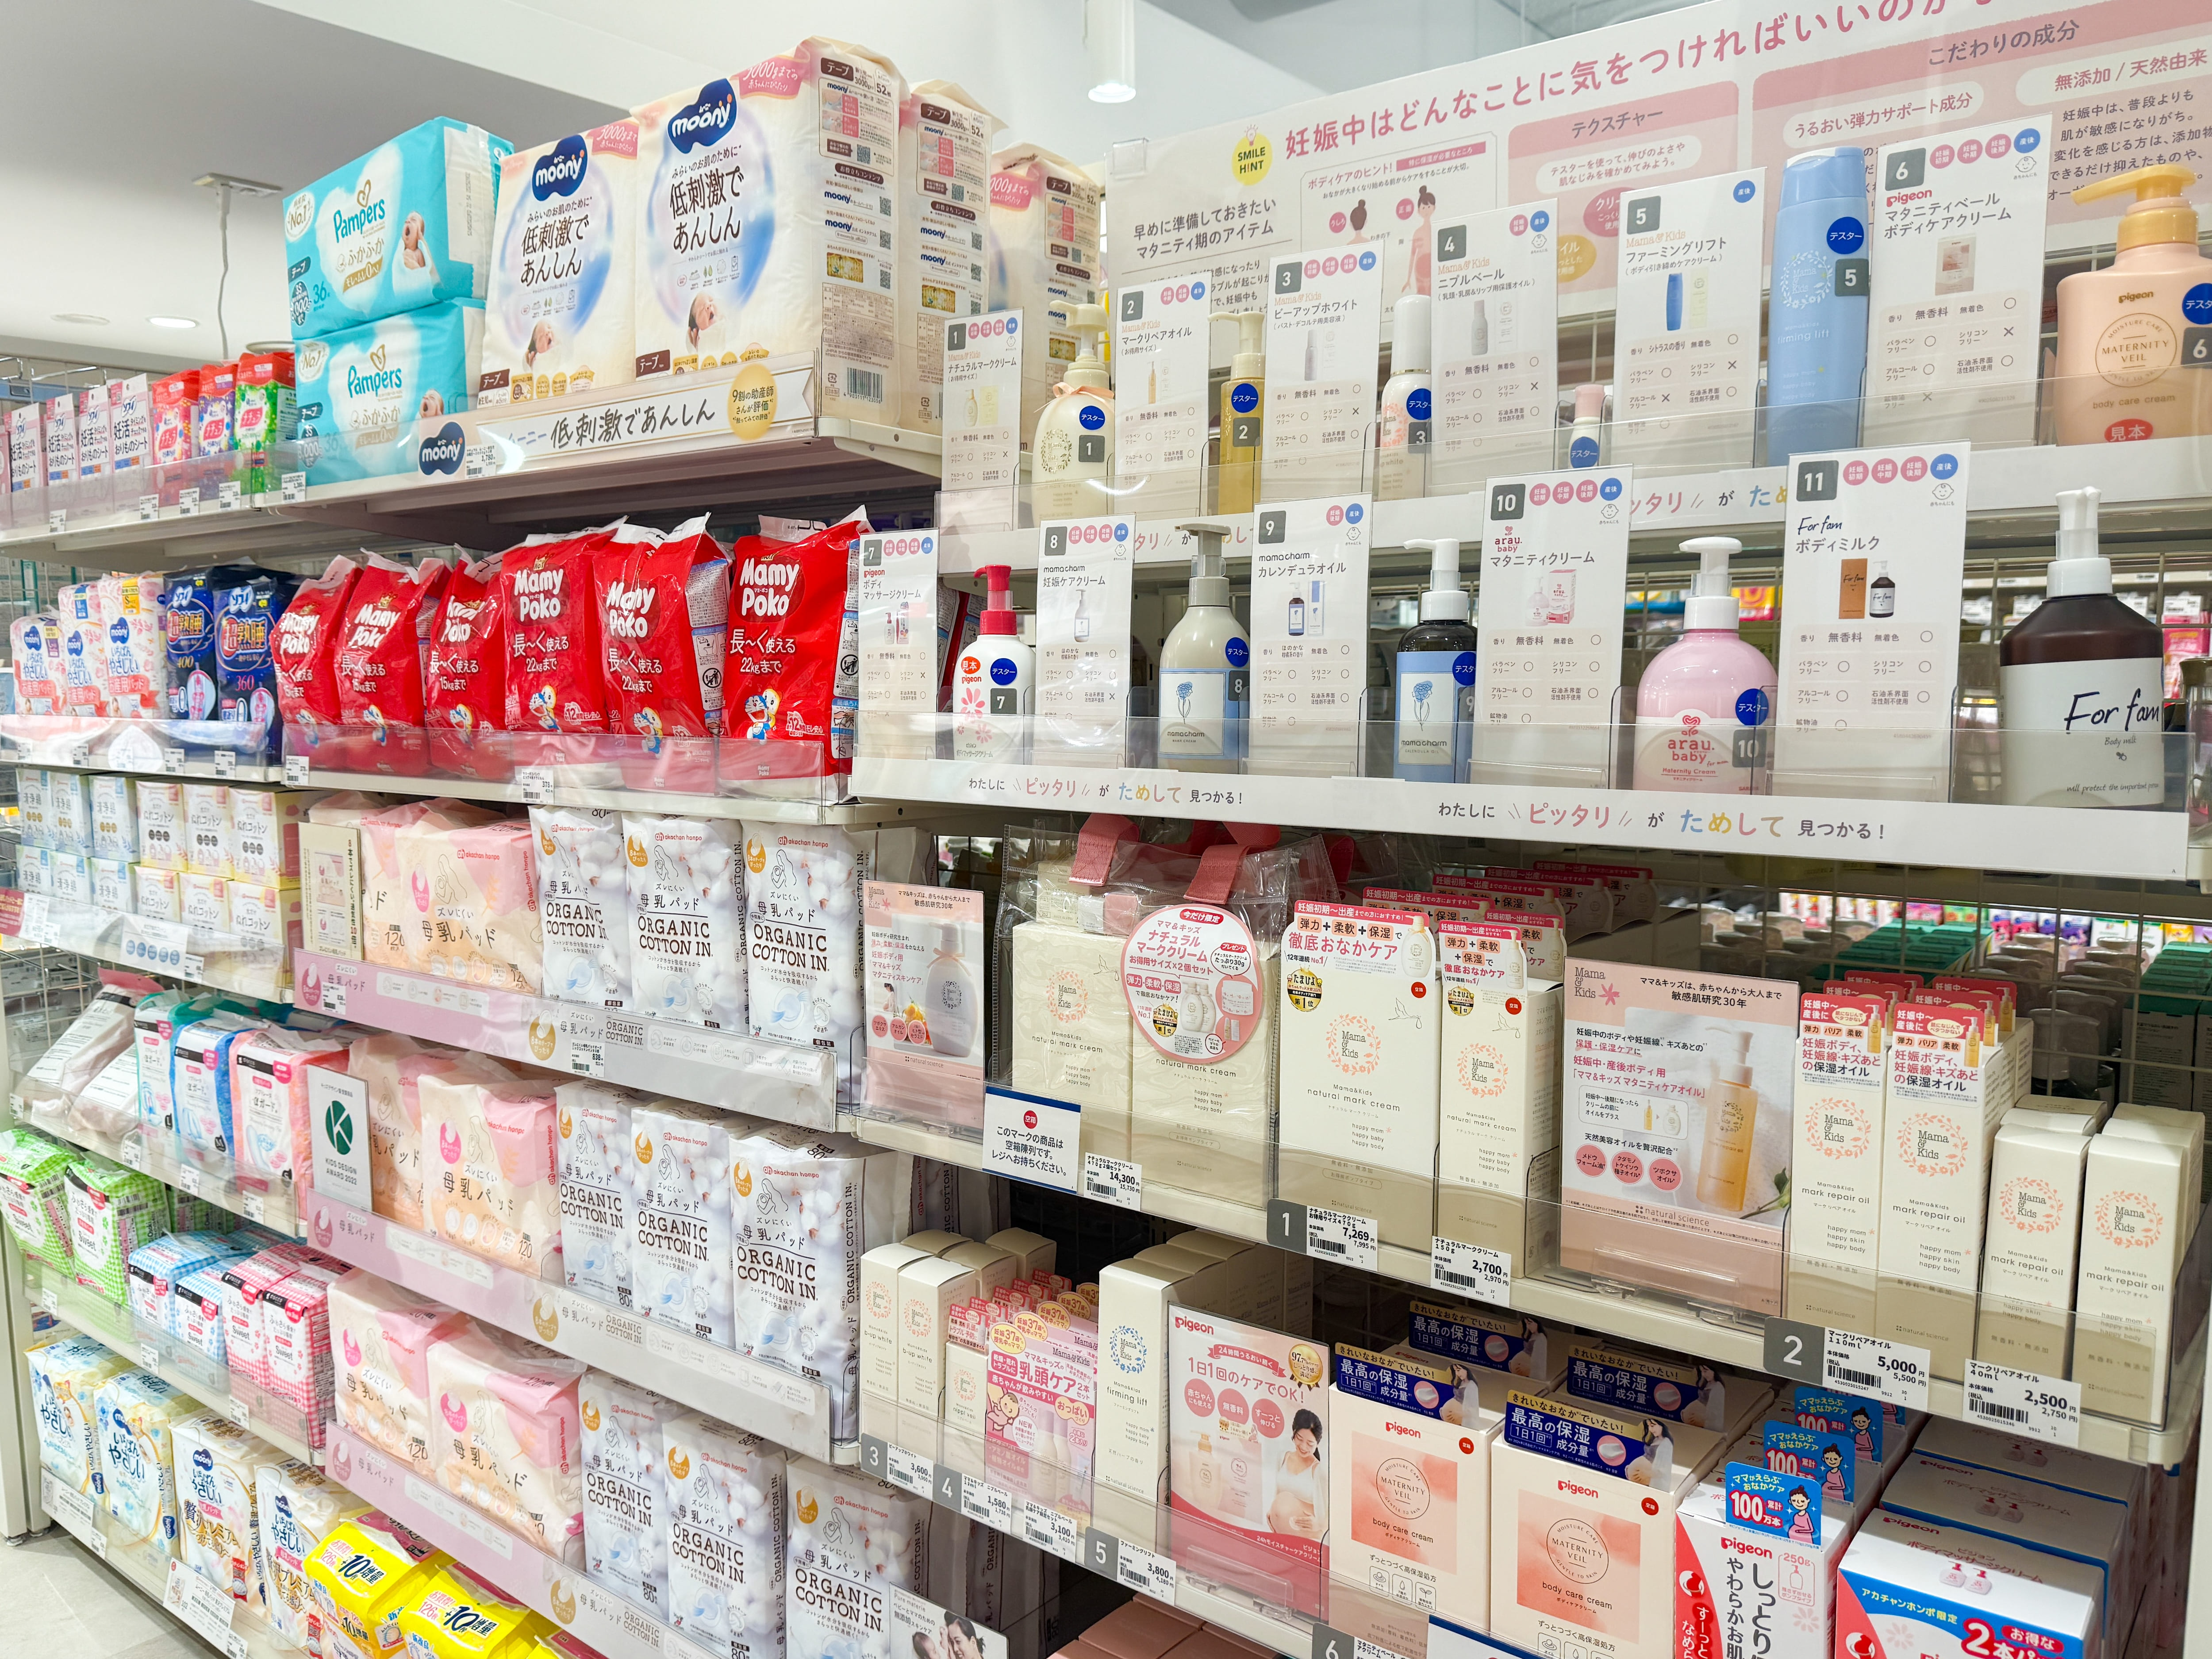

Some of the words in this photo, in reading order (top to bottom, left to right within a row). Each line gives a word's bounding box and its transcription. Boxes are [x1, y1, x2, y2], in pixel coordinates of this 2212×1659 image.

[1929, 20, 2079, 66] こだわりの成分
[1285, 0, 1991, 160] 妊娠中はどんなことに気をつければいいの
[2054, 67, 2110, 92] 無添加
[2130, 49, 2207, 78] 天然由来
[1795, 92, 1973, 138] うるおい弾力サポート成分
[2063, 89, 2193, 122] 妊娠中は、普段よりも
[1572, 111, 1663, 138] テクスチャー
[2061, 111, 2193, 142] 肌が敏感になりがち。
[1238, 147, 1266, 161] SMILE
[1551, 143, 1685, 175] テスターを使って、伸びのよさや
[1559, 159, 1675, 187] 肌なじみを確かめてみよう。
[1895, 161, 1909, 180] 6
[669, 166, 744, 220] 低刺激で
[1887, 188, 1932, 207] pigeon
[1886, 193, 2000, 221] マタニティベール
[334, 199, 385, 243] Pampers
[1134, 198, 1276, 241] 早めに準備しておきたい
[1885, 208, 2012, 240] ボディケアクリーム
[521, 214, 589, 257] 低刺激で
[1137, 219, 1273, 259] マタニティ期のアイテム
[1626, 236, 1727, 263] ファーミングリフト
[521, 248, 582, 287] あんしん
[1438, 268, 1504, 289] ニプルベール
[2118, 290, 2154, 303] pigeon
[1274, 300, 1358, 319] ビーアップホワイト
[1916, 307, 1948, 319] 無香料
[1122, 328, 1191, 345] マークリペアオイル
[1649, 341, 1686, 353] シトラスの香り
[2102, 339, 2170, 355] MATERNITY
[948, 357, 1016, 373] ナチュラルマーククリーム
[732, 386, 774, 403] 9割の助産師
[1690, 388, 1720, 396] 石油系界面
[2093, 399, 2115, 409] body
[2119, 397, 2140, 406] care
[2144, 394, 2175, 403] cream
[551, 398, 715, 449] 低刺激であんしん
[2111, 425, 2145, 442] 見本
[115, 438, 148, 456] おりものシート
[1804, 472, 1824, 492] 11
[1797, 516, 1821, 534] For
[1821, 516, 1843, 531] fam
[1495, 536, 1522, 545] arau.
[1796, 536, 1880, 553] ボディミルク
[1490, 551, 1594, 568] マタニティクリーム
[739, 557, 799, 591] Mamy
[1258, 563, 1346, 578] カレンデュラオイル
[514, 566, 564, 596] Mamy
[1043, 575, 1106, 588] 妊娠ケアクリーム
[864, 588, 921, 599] マッサージクリーム
[518, 594, 561, 621] Poko
[741, 591, 789, 618] Poko
[222, 619, 265, 651] 超熟睡
[740, 656, 781, 674] 22kgまで
[2064, 691, 2119, 734] For
[2125, 688, 2159, 731] fam
[2105, 737, 2121, 747] Body
[969, 779, 1005, 790] わたしに
[1026, 778, 1076, 797] ピッタリ
[1099, 784, 1110, 796] が
[1118, 782, 1182, 804] ためして
[1438, 803, 1495, 818] わたしに
[1529, 803, 1609, 829] ピッタリ
[1648, 812, 1665, 827] が
[1681, 809, 1784, 837] ためして
[914, 899, 953, 910] 敏感肌研究30年
[1183, 912, 1221, 923] 今だけ限定
[422, 920, 495, 948] 母乳パッド
[753, 923, 828, 952] ORGANIC
[753, 942, 807, 968] COTTON
[1137, 942, 1207, 963] マーククリーム
[1289, 932, 1398, 960] 徹底おなかケア
[1671, 991, 1747, 1009] 敏感肌研究30年
[1803, 1011, 1829, 1019] 産後に
[607, 1021, 643, 1036] ORGANIC
[1342, 1031, 1366, 1043] Mama
[1342, 1047, 1359, 1059] Kids
[1803, 1061, 1869, 1076] の保湿オイル
[1307, 1088, 1340, 1100] natural
[1344, 1096, 1367, 1105] mark
[1371, 1101, 1400, 1112] cream
[1586, 1101, 1619, 1111] クリームの前に
[997, 1126, 1064, 1148] このマークの商品は
[1006, 1140, 1053, 1160] 空箱陳列です。
[325, 1157, 335, 1167] KIDS
[337, 1160, 357, 1175] DESIGN
[992, 1150, 1067, 1176] レジへお持ちください。
[326, 1168, 344, 1179] AWARD
[345, 1175, 357, 1185] 2022
[1110, 1172, 1135, 1185] 14,300
[1802, 1187, 1825, 1197] mark
[1828, 1190, 1855, 1202] repair
[1859, 1195, 1870, 1204] oil
[1309, 1207, 1366, 1225] ナチュラルマーククリーム
[1645, 1206, 1676, 1221] natural
[1678, 1215, 1709, 1226] science
[1343, 1227, 1369, 1242] 7,269
[1472, 1260, 1502, 1275] 2,700
[1175, 1316, 1214, 1335] pigeon
[1828, 1329, 1891, 1350] マークリペアオイル
[1218, 1346, 1273, 1367] 24時間うるおい続く
[1783, 1335, 1803, 1366] 2
[1341, 1359, 1408, 1390] 最高の保湿
[1878, 1356, 1917, 1375] 5,000
[1019, 1361, 1076, 1393] 乳頭ケア
[992, 1375, 1053, 1401] 赤ちゃんが飲みやすい
[1107, 1386, 1134, 1403] firming
[1137, 1395, 1148, 1406] lift
[2024, 1390, 2068, 1410] 2,500
[1019, 1420, 1033, 1429] NEW
[1256, 1408, 1280, 1423] すーっと
[1385, 1421, 1421, 1439] pigeon
[910, 1463, 928, 1477] 3,600
[1743, 1482, 1785, 1494] おなかケア
[1732, 1490, 1763, 1519] 100
[1148, 1562, 1169, 1579] 3,800
[1370, 1553, 1436, 1583] ずっとつづく高保湿処方
[894, 1603, 935, 1625] ベビーとママのための
[1862, 1588, 1957, 1625] アカチャンホンポ限定
